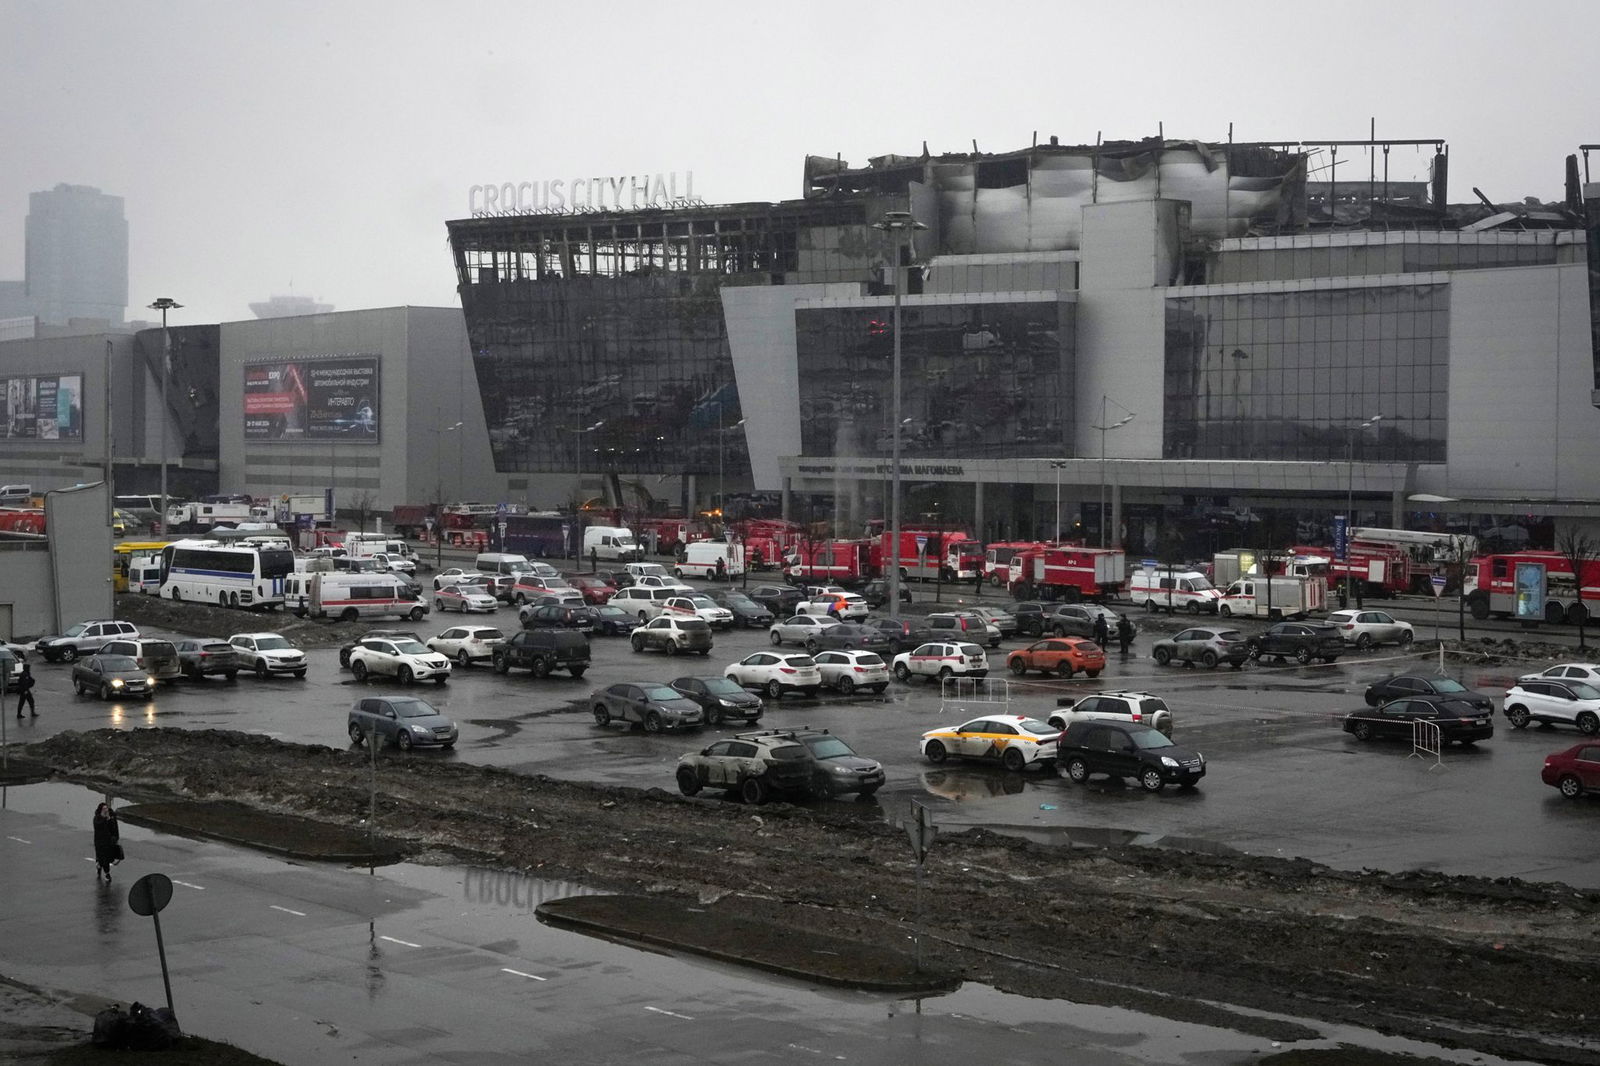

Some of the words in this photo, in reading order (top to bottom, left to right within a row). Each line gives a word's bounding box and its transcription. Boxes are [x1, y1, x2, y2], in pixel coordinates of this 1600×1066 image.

[468, 179, 565, 213] CROCUS
[570, 175, 627, 210] CITY
[631, 170, 702, 205] HALL
